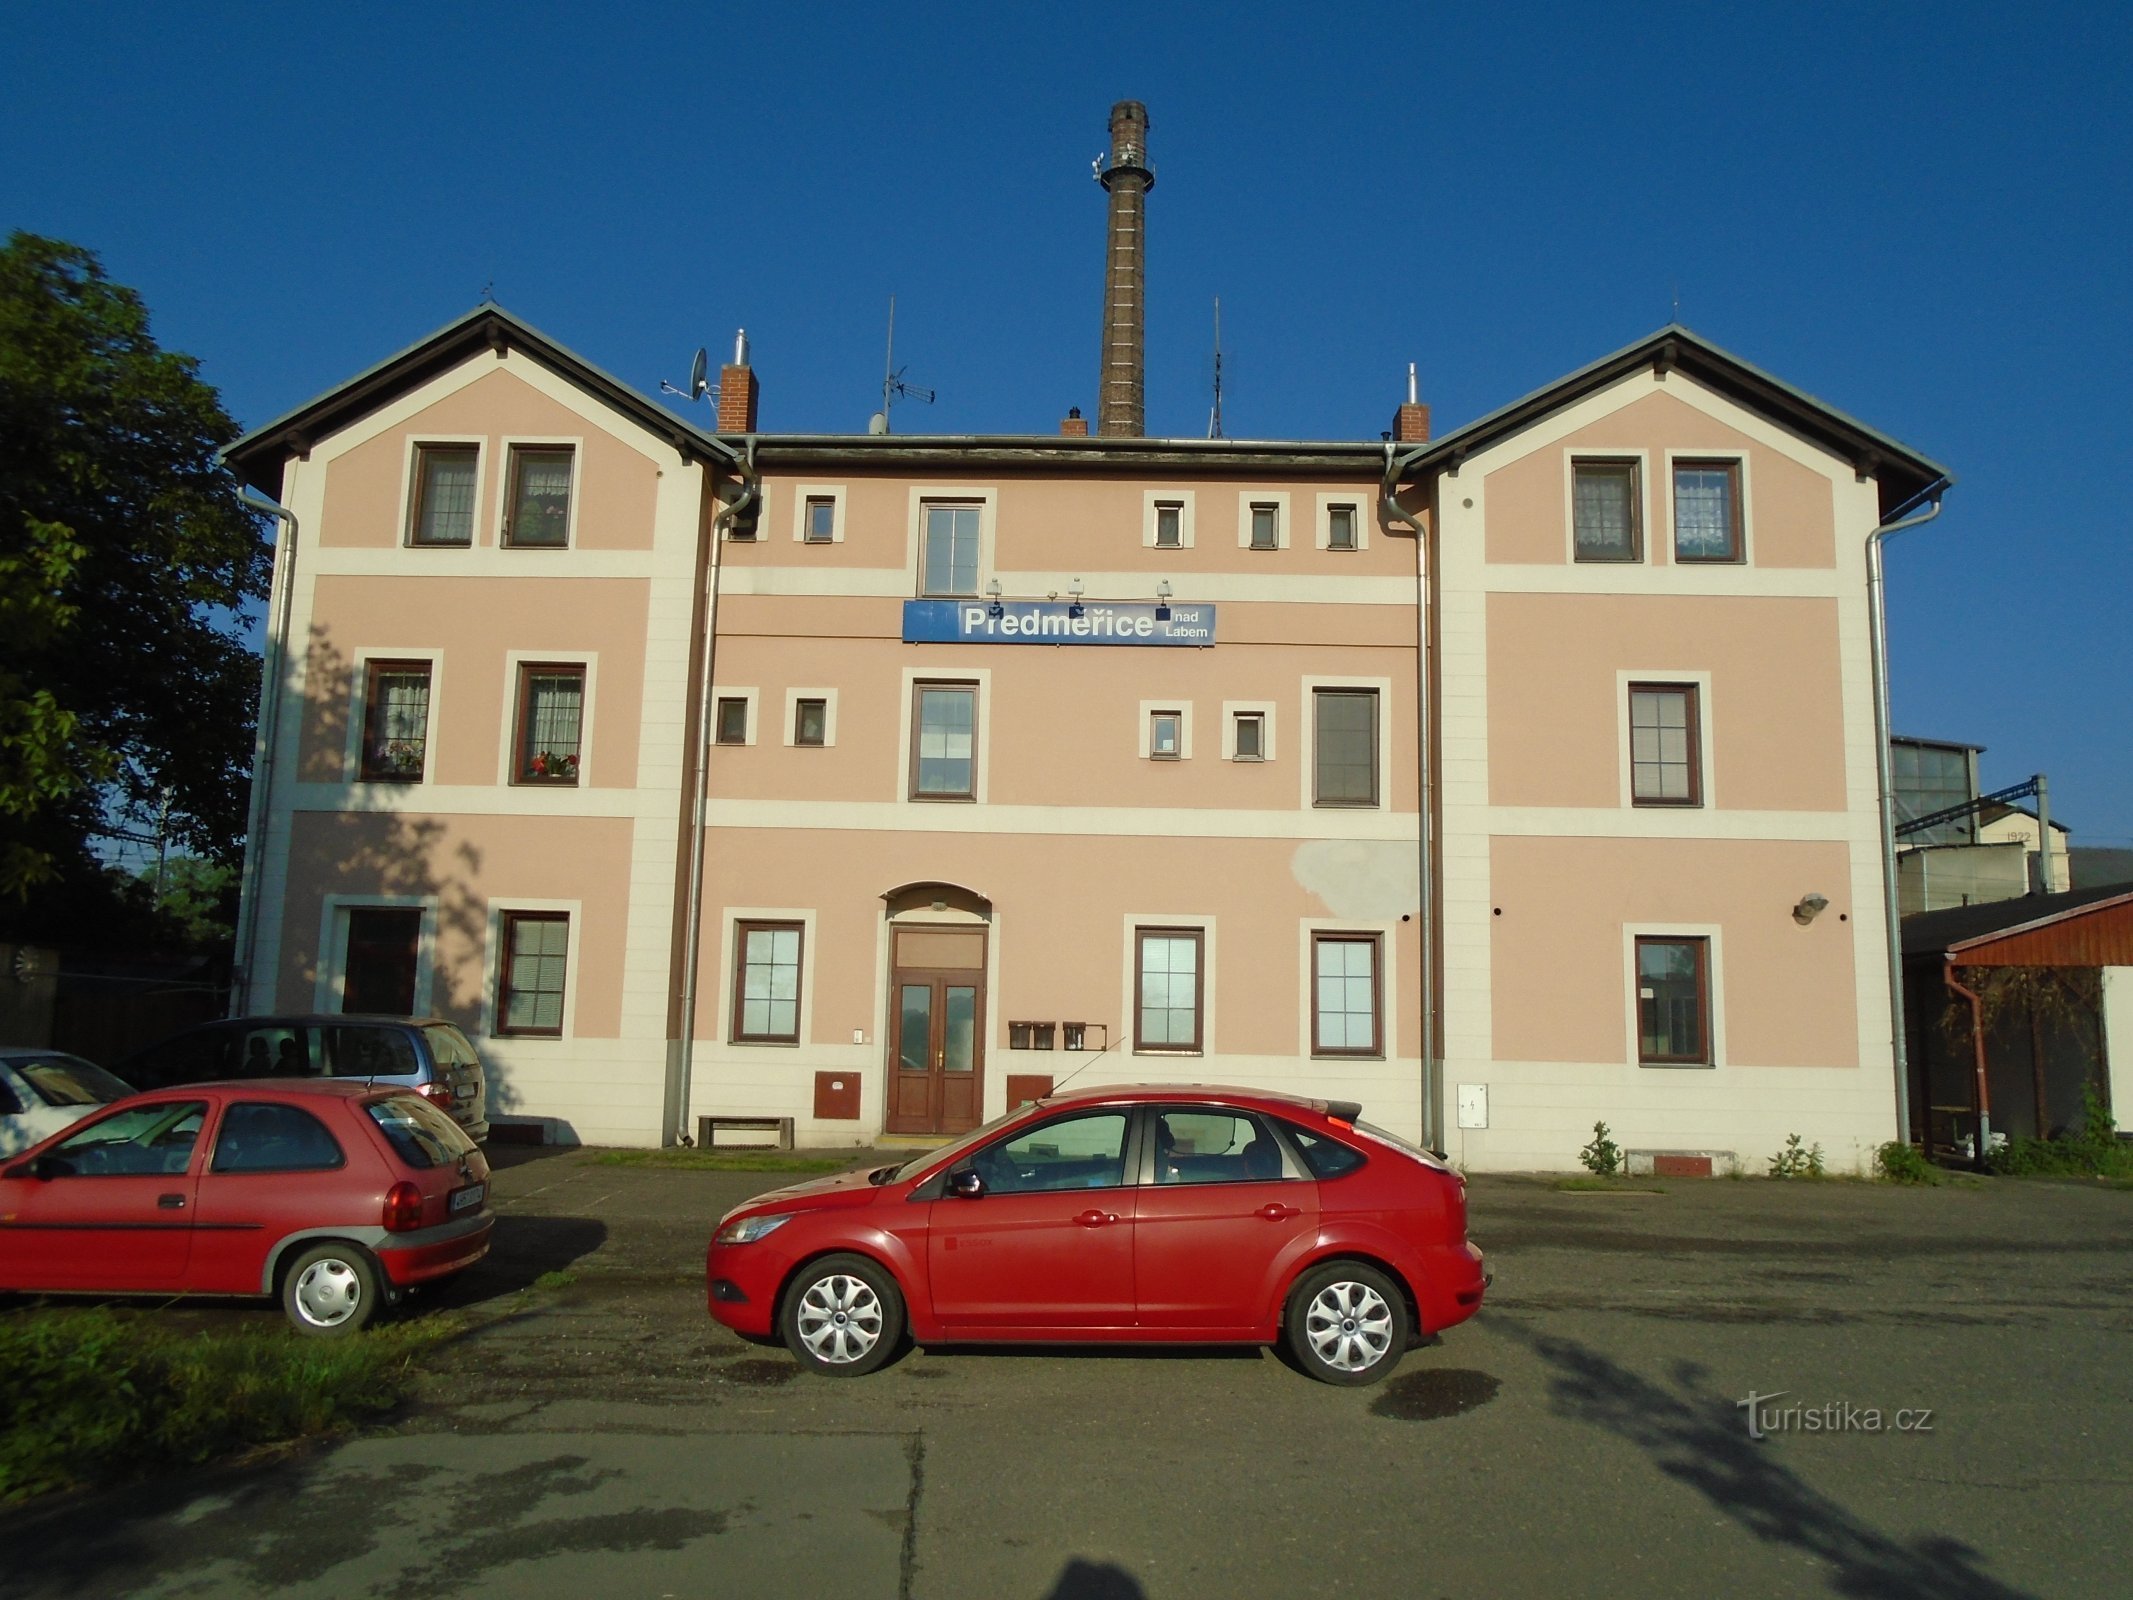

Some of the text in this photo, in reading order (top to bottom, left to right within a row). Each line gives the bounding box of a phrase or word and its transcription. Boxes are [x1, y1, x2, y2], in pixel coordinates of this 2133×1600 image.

[1175, 611, 1199, 622] nad
[1165, 626, 1208, 638] Labem
[2007, 831, 2031, 842] 1922
